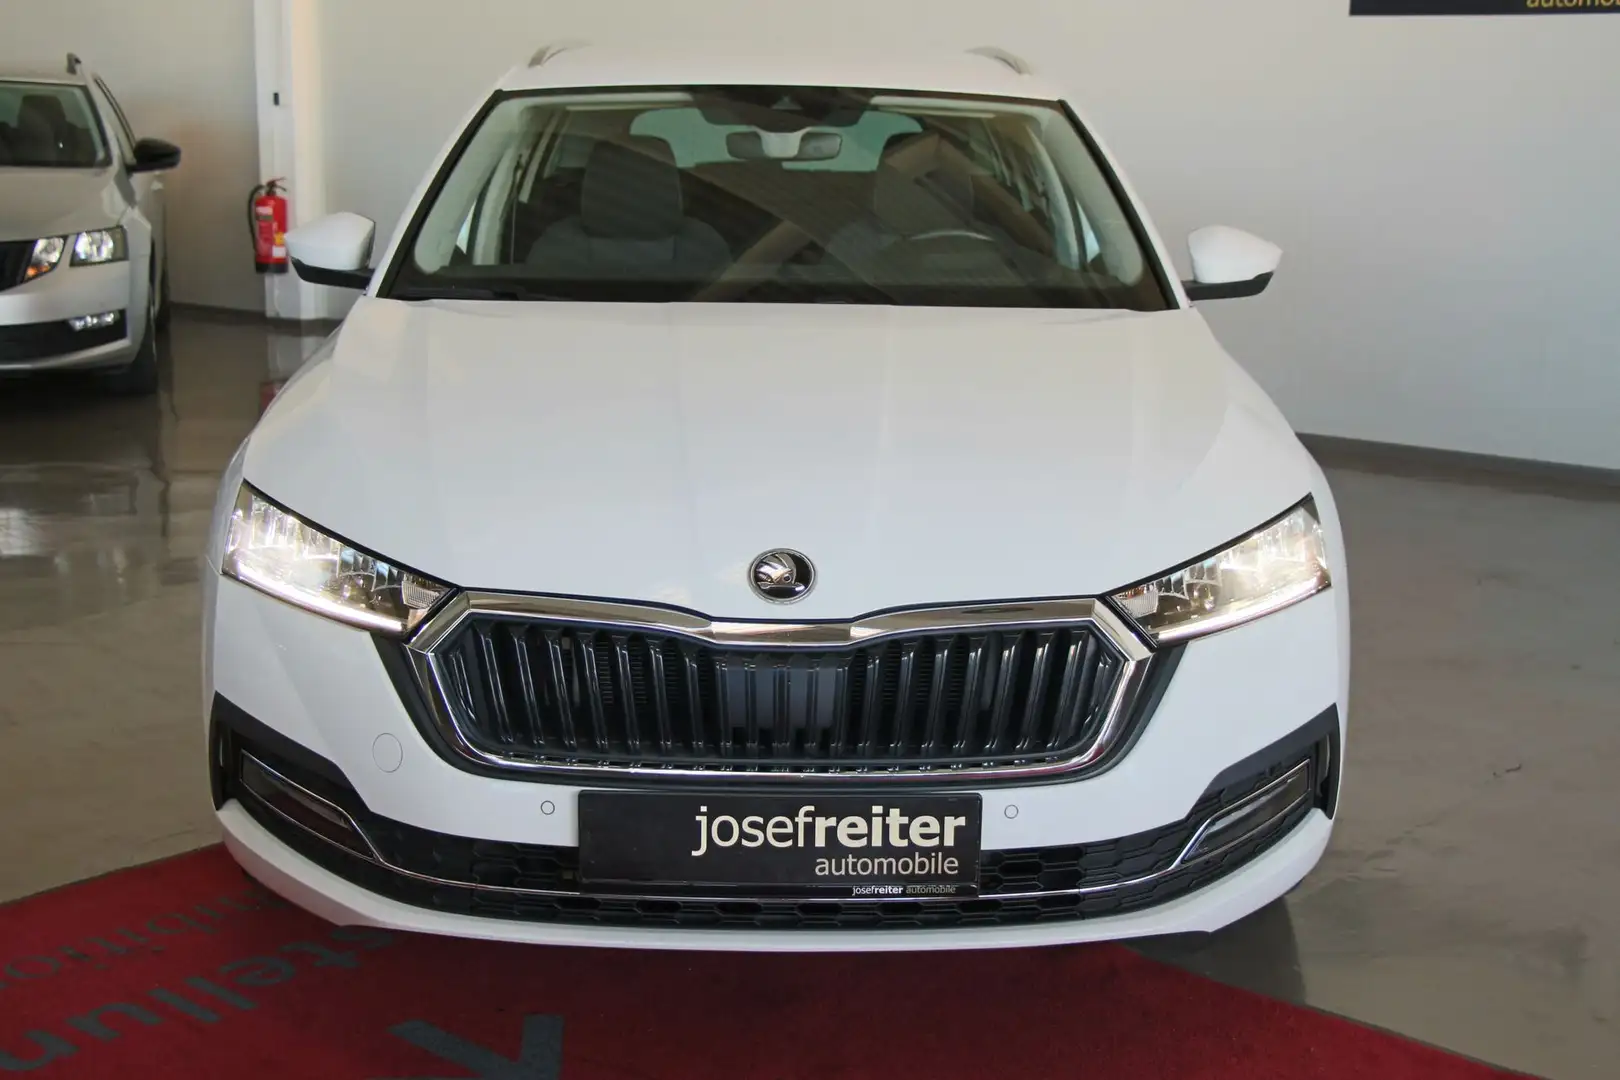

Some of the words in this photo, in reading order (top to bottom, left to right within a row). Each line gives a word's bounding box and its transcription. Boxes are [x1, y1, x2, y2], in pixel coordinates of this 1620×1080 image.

[1525, 0, 1620, 8] automo
[692, 805, 966, 856] josefreiter
[815, 852, 959, 876] automobile
[852, 885, 904, 896] josefreiter
[906, 885, 956, 894] automobile
